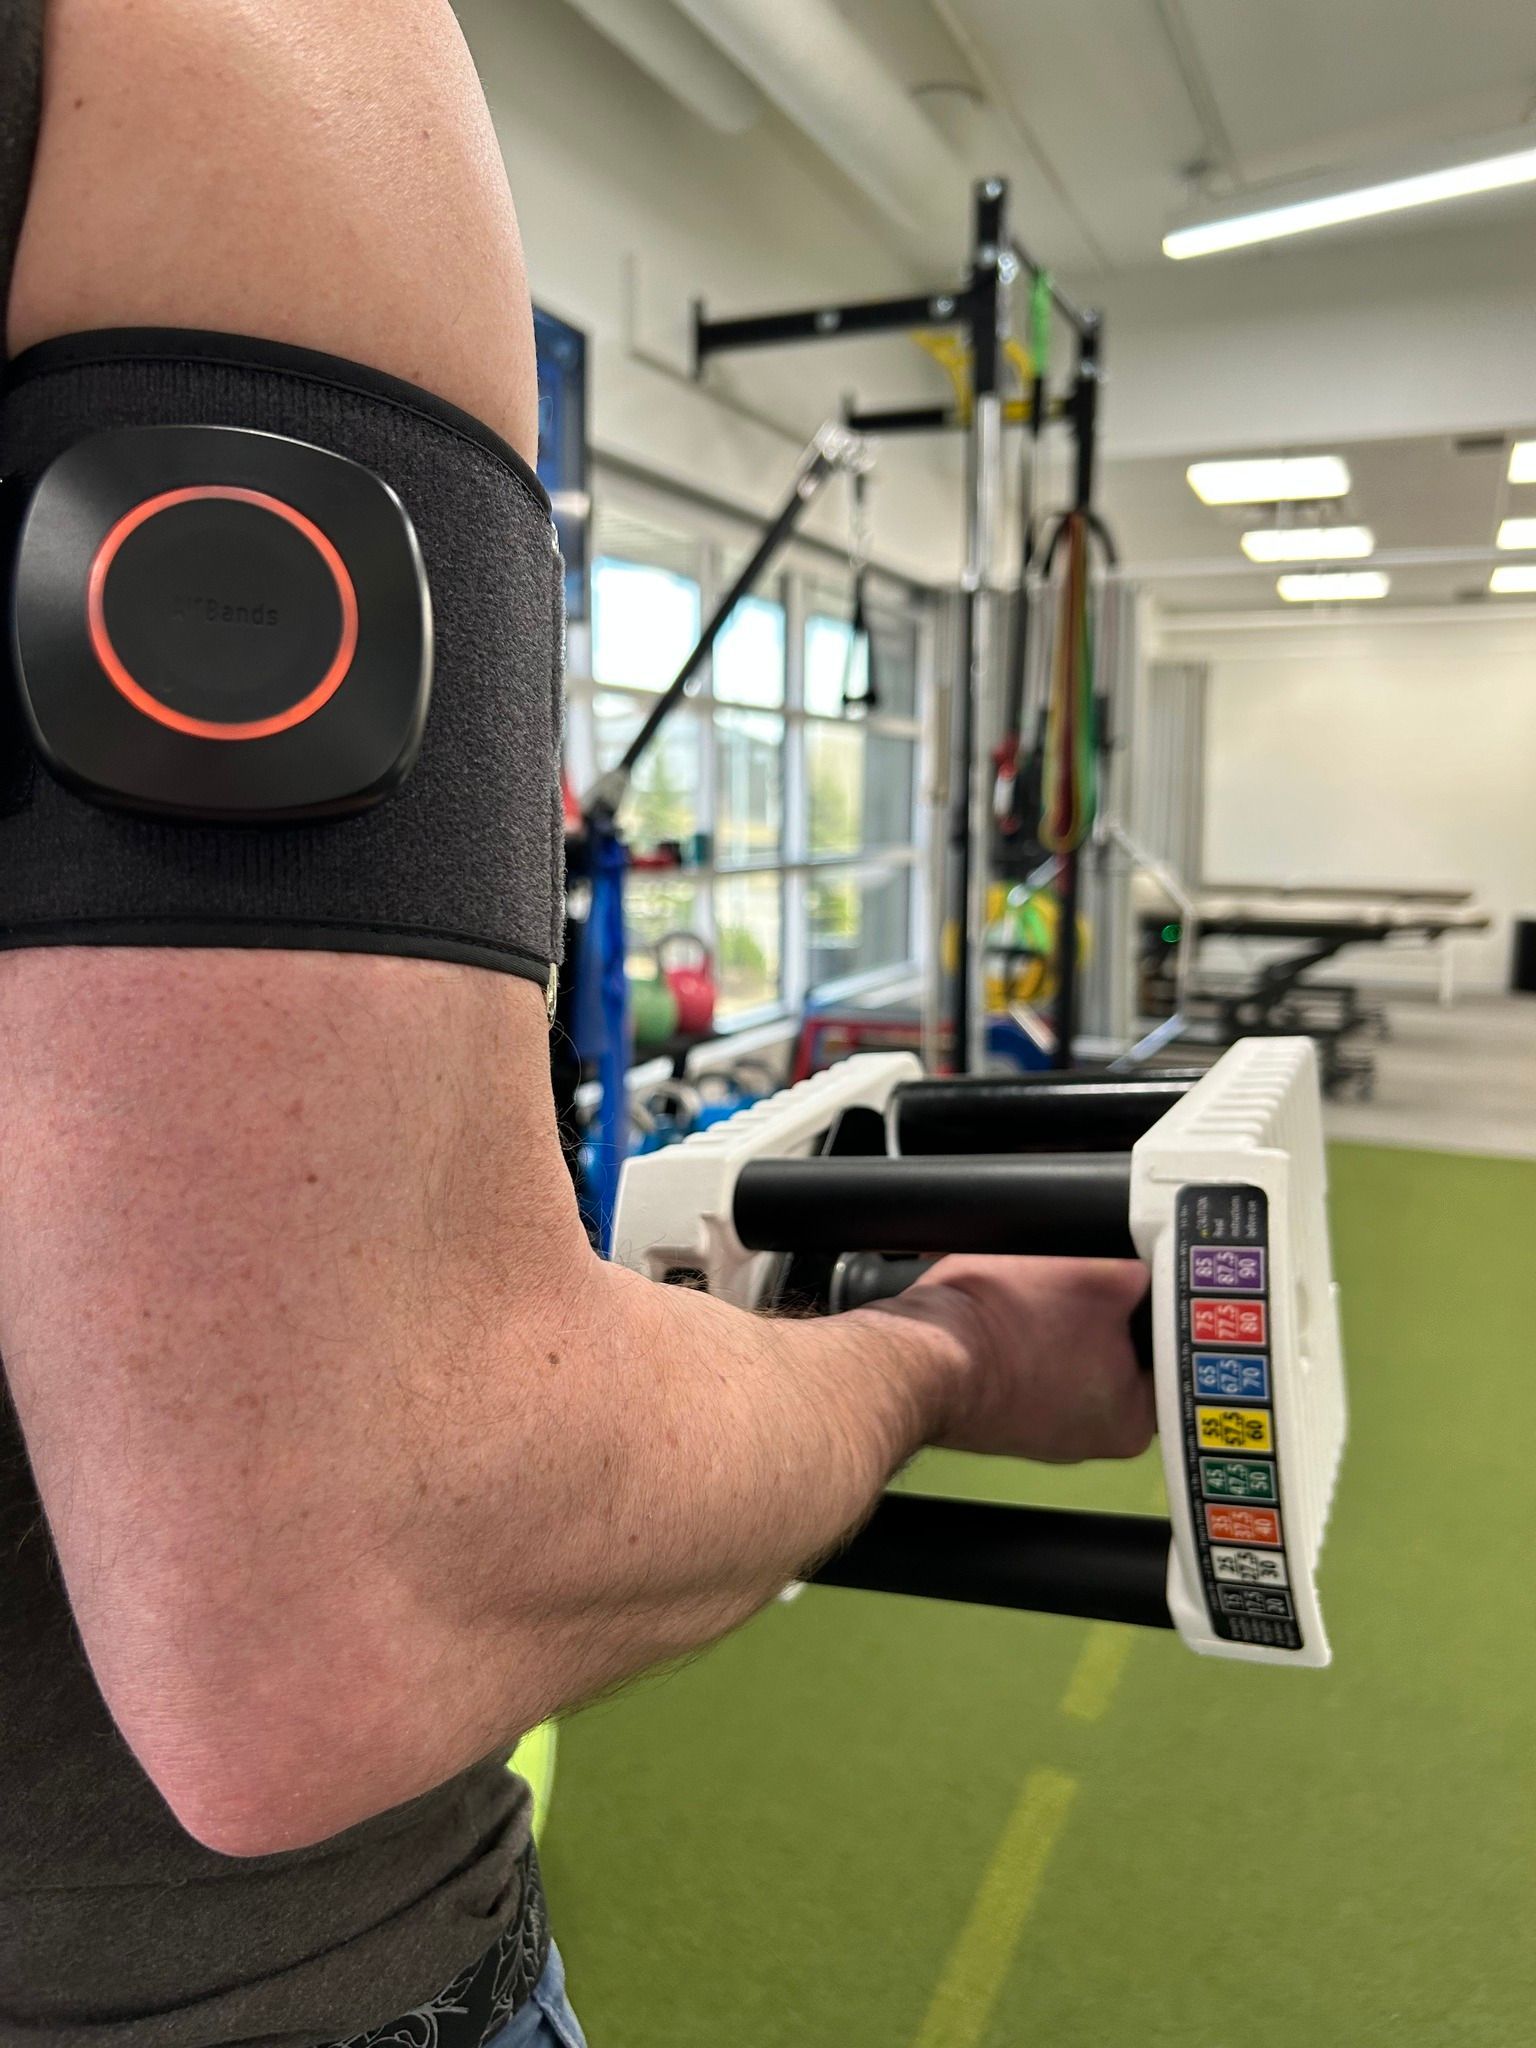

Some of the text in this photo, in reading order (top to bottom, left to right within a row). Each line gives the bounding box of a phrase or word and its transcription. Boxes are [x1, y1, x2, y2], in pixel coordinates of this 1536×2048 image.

[1196, 1256, 1212, 1278] 85
[1217, 1251, 1235, 1285] 87.5
[1239, 1258, 1257, 1278] 90
[1197, 1310, 1214, 1331] 75
[1217, 1304, 1237, 1338] 77.5
[1240, 1312, 1258, 1333] 80
[1199, 1365, 1216, 1385] 65
[1220, 1360, 1240, 1394] 67.5
[1243, 1366, 1261, 1388] 70
[1203, 1417, 1220, 1437] 55
[1223, 1411, 1243, 1446] 57.5
[1246, 1419, 1264, 1441] 60
[1207, 1469, 1225, 1489] 45
[1228, 1464, 1248, 1496] 47.5
[1250, 1471, 1269, 1490] 50
[1211, 1515, 1231, 1532] 35
[1232, 1511, 1254, 1538] 37.5
[1254, 1518, 1273, 1536] 40
[1217, 1556, 1235, 1572] 25
[1260, 1560, 1279, 1578] 30
